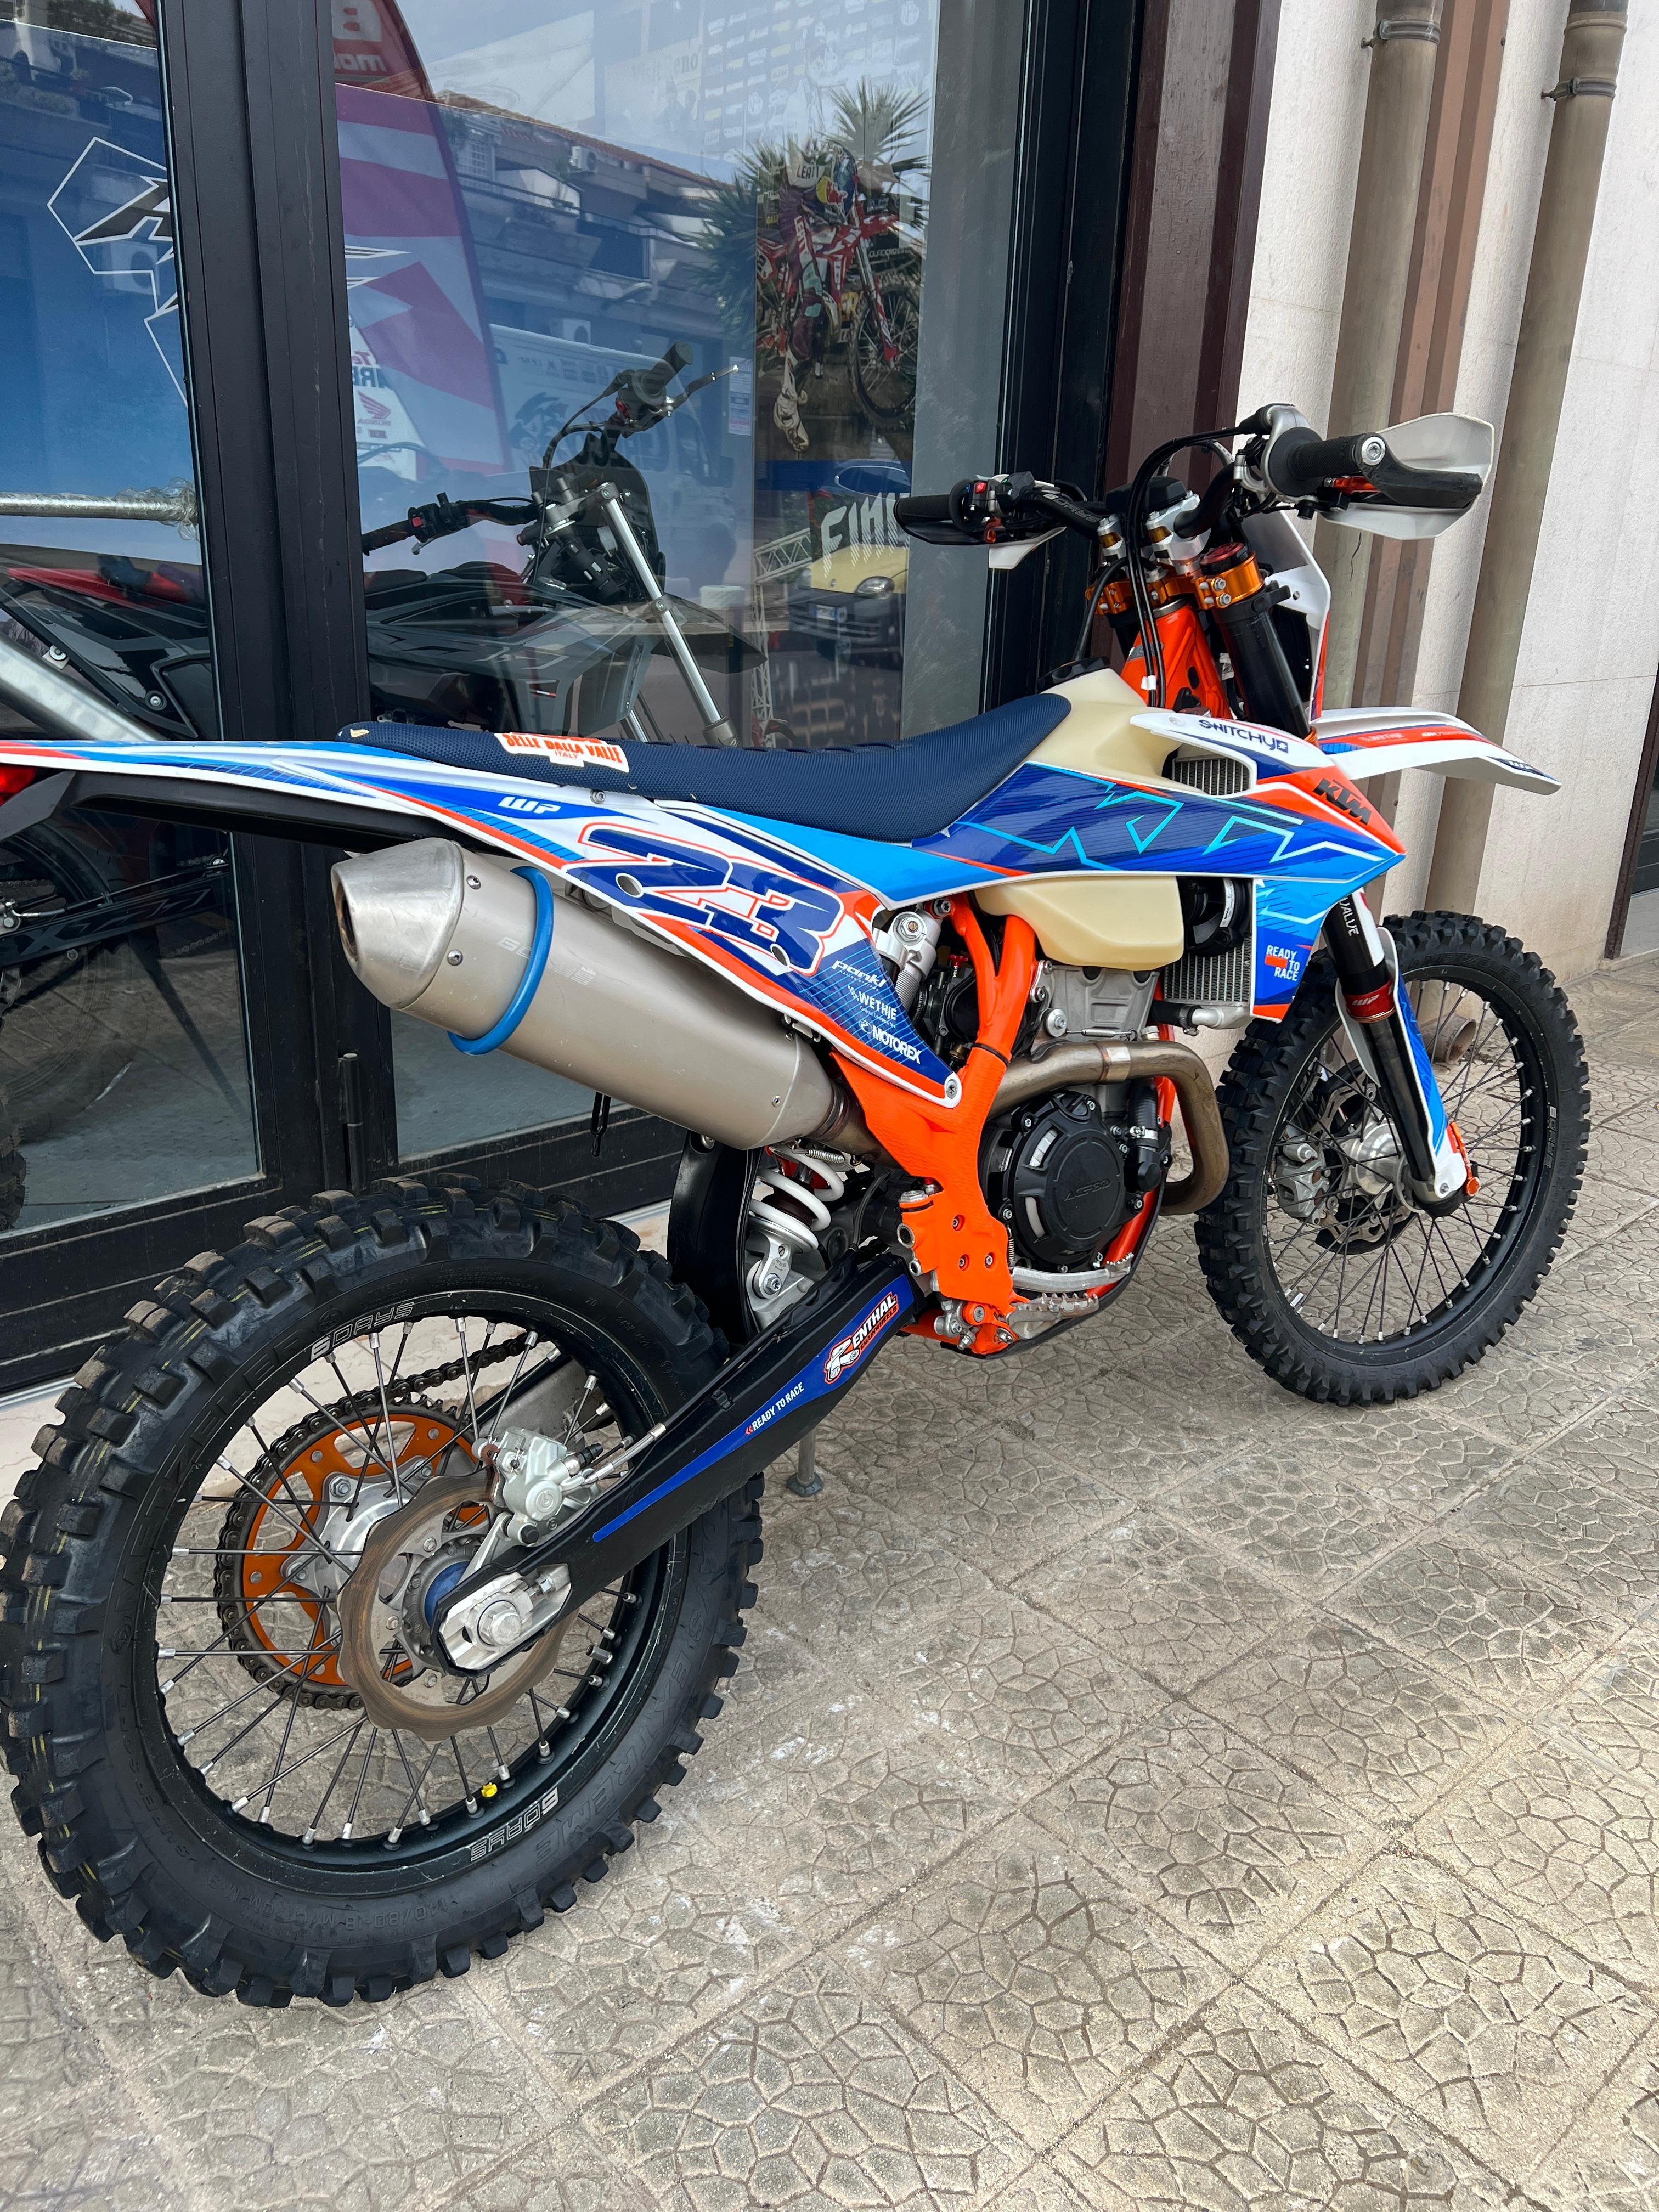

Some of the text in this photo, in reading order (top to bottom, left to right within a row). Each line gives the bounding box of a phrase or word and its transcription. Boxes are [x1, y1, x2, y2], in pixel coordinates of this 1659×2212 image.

[503, 733, 623, 764] SELLE DALLA VALLE
[555, 751, 578, 759] ITALY
[498, 796, 561, 814] WP
[1312, 777, 1373, 826] KTM
[1266, 945, 1297, 961] READY
[1289, 960, 1300, 972] TO
[1274, 966, 1300, 981] RACE
[859, 991, 897, 1021] WETHJE
[1351, 994, 1380, 1006] WP
[872, 1025, 922, 1064] MOTOREX
[310, 1301, 414, 1362] 6DAYS
[752, 1382, 805, 1431] READY TO RACE
[470, 1786, 560, 1863] 6DAYS
